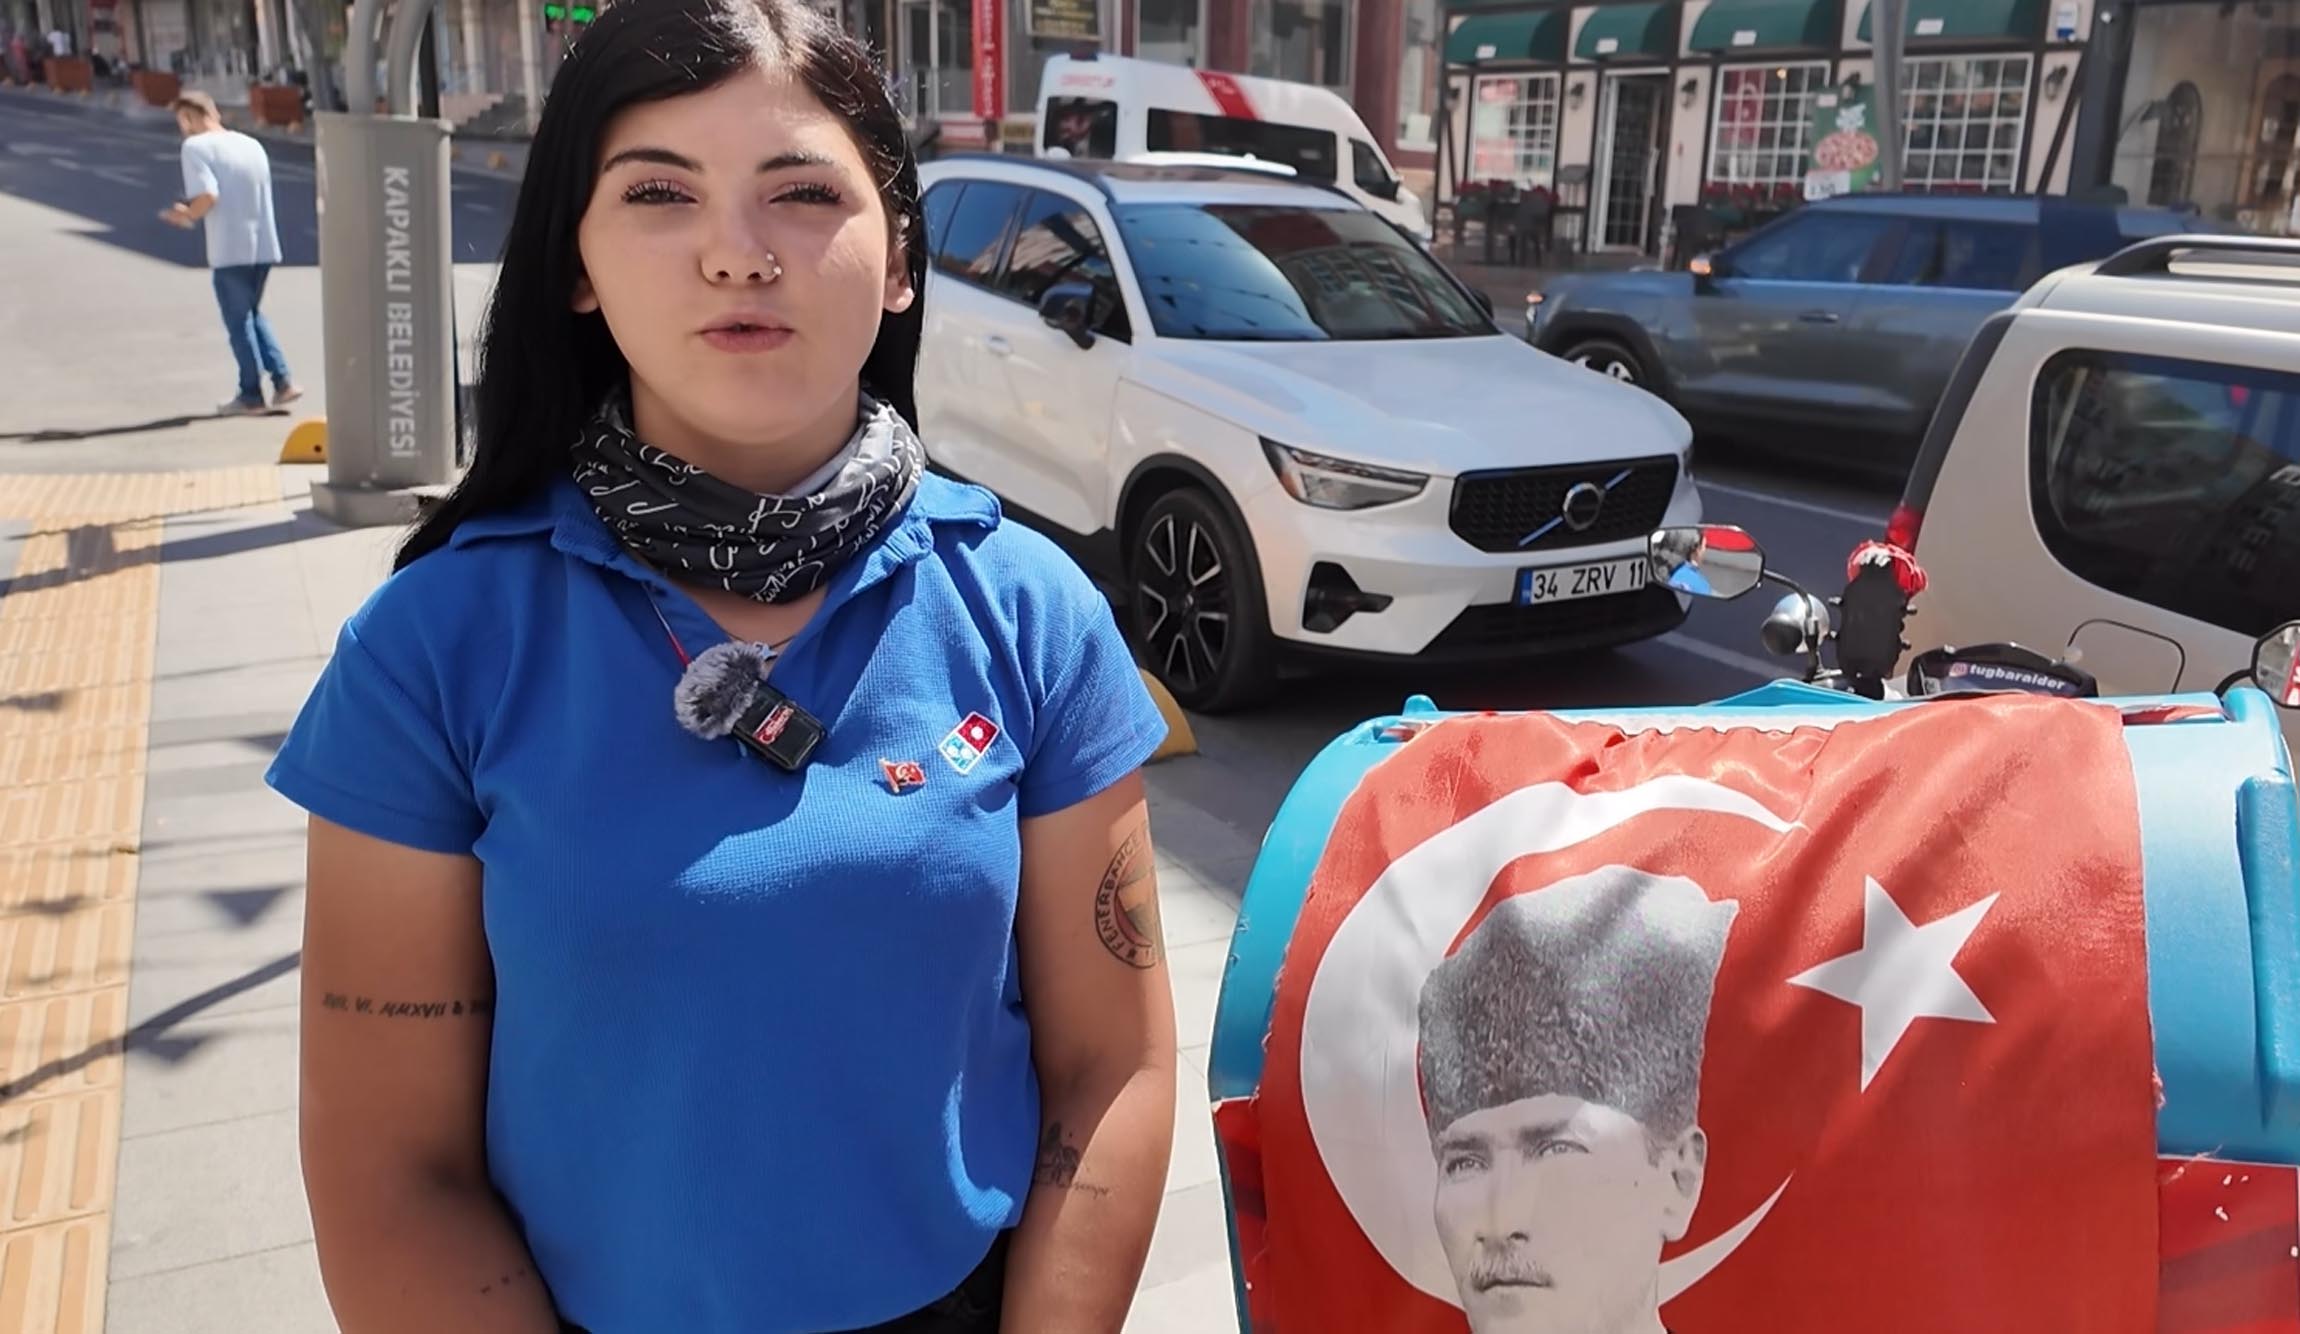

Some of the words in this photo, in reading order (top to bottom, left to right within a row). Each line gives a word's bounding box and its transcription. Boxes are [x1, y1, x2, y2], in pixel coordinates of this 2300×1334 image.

[384, 166, 412, 292] KAPAKLI
[387, 302, 421, 457] BELEDİYESİ
[1534, 572, 1558, 600] 34
[1571, 564, 1617, 595] ZRV
[1969, 663, 2066, 690] tugbaraider
